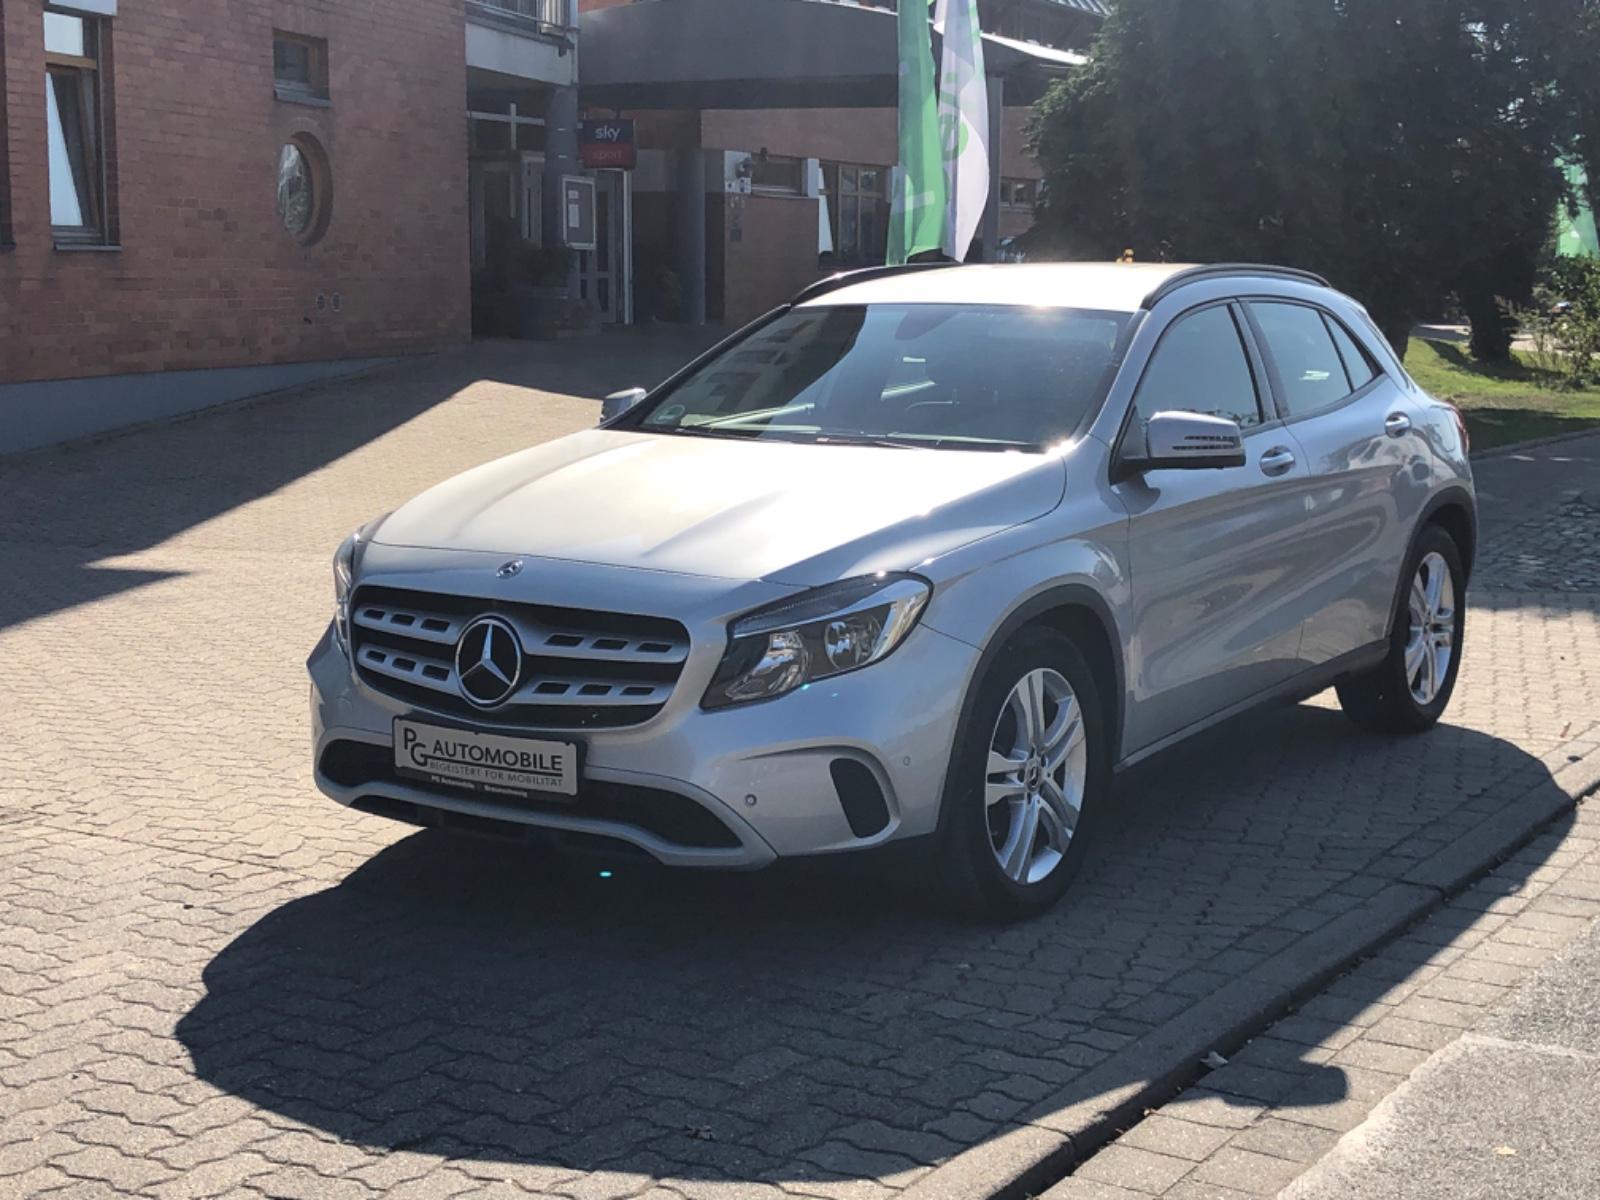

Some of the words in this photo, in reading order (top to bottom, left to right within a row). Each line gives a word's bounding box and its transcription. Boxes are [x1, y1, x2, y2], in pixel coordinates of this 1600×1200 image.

[595, 125, 621, 142] sky
[433, 739, 563, 772] AUTOMOBILE
[429, 761, 481, 778] BEGEISTERT
